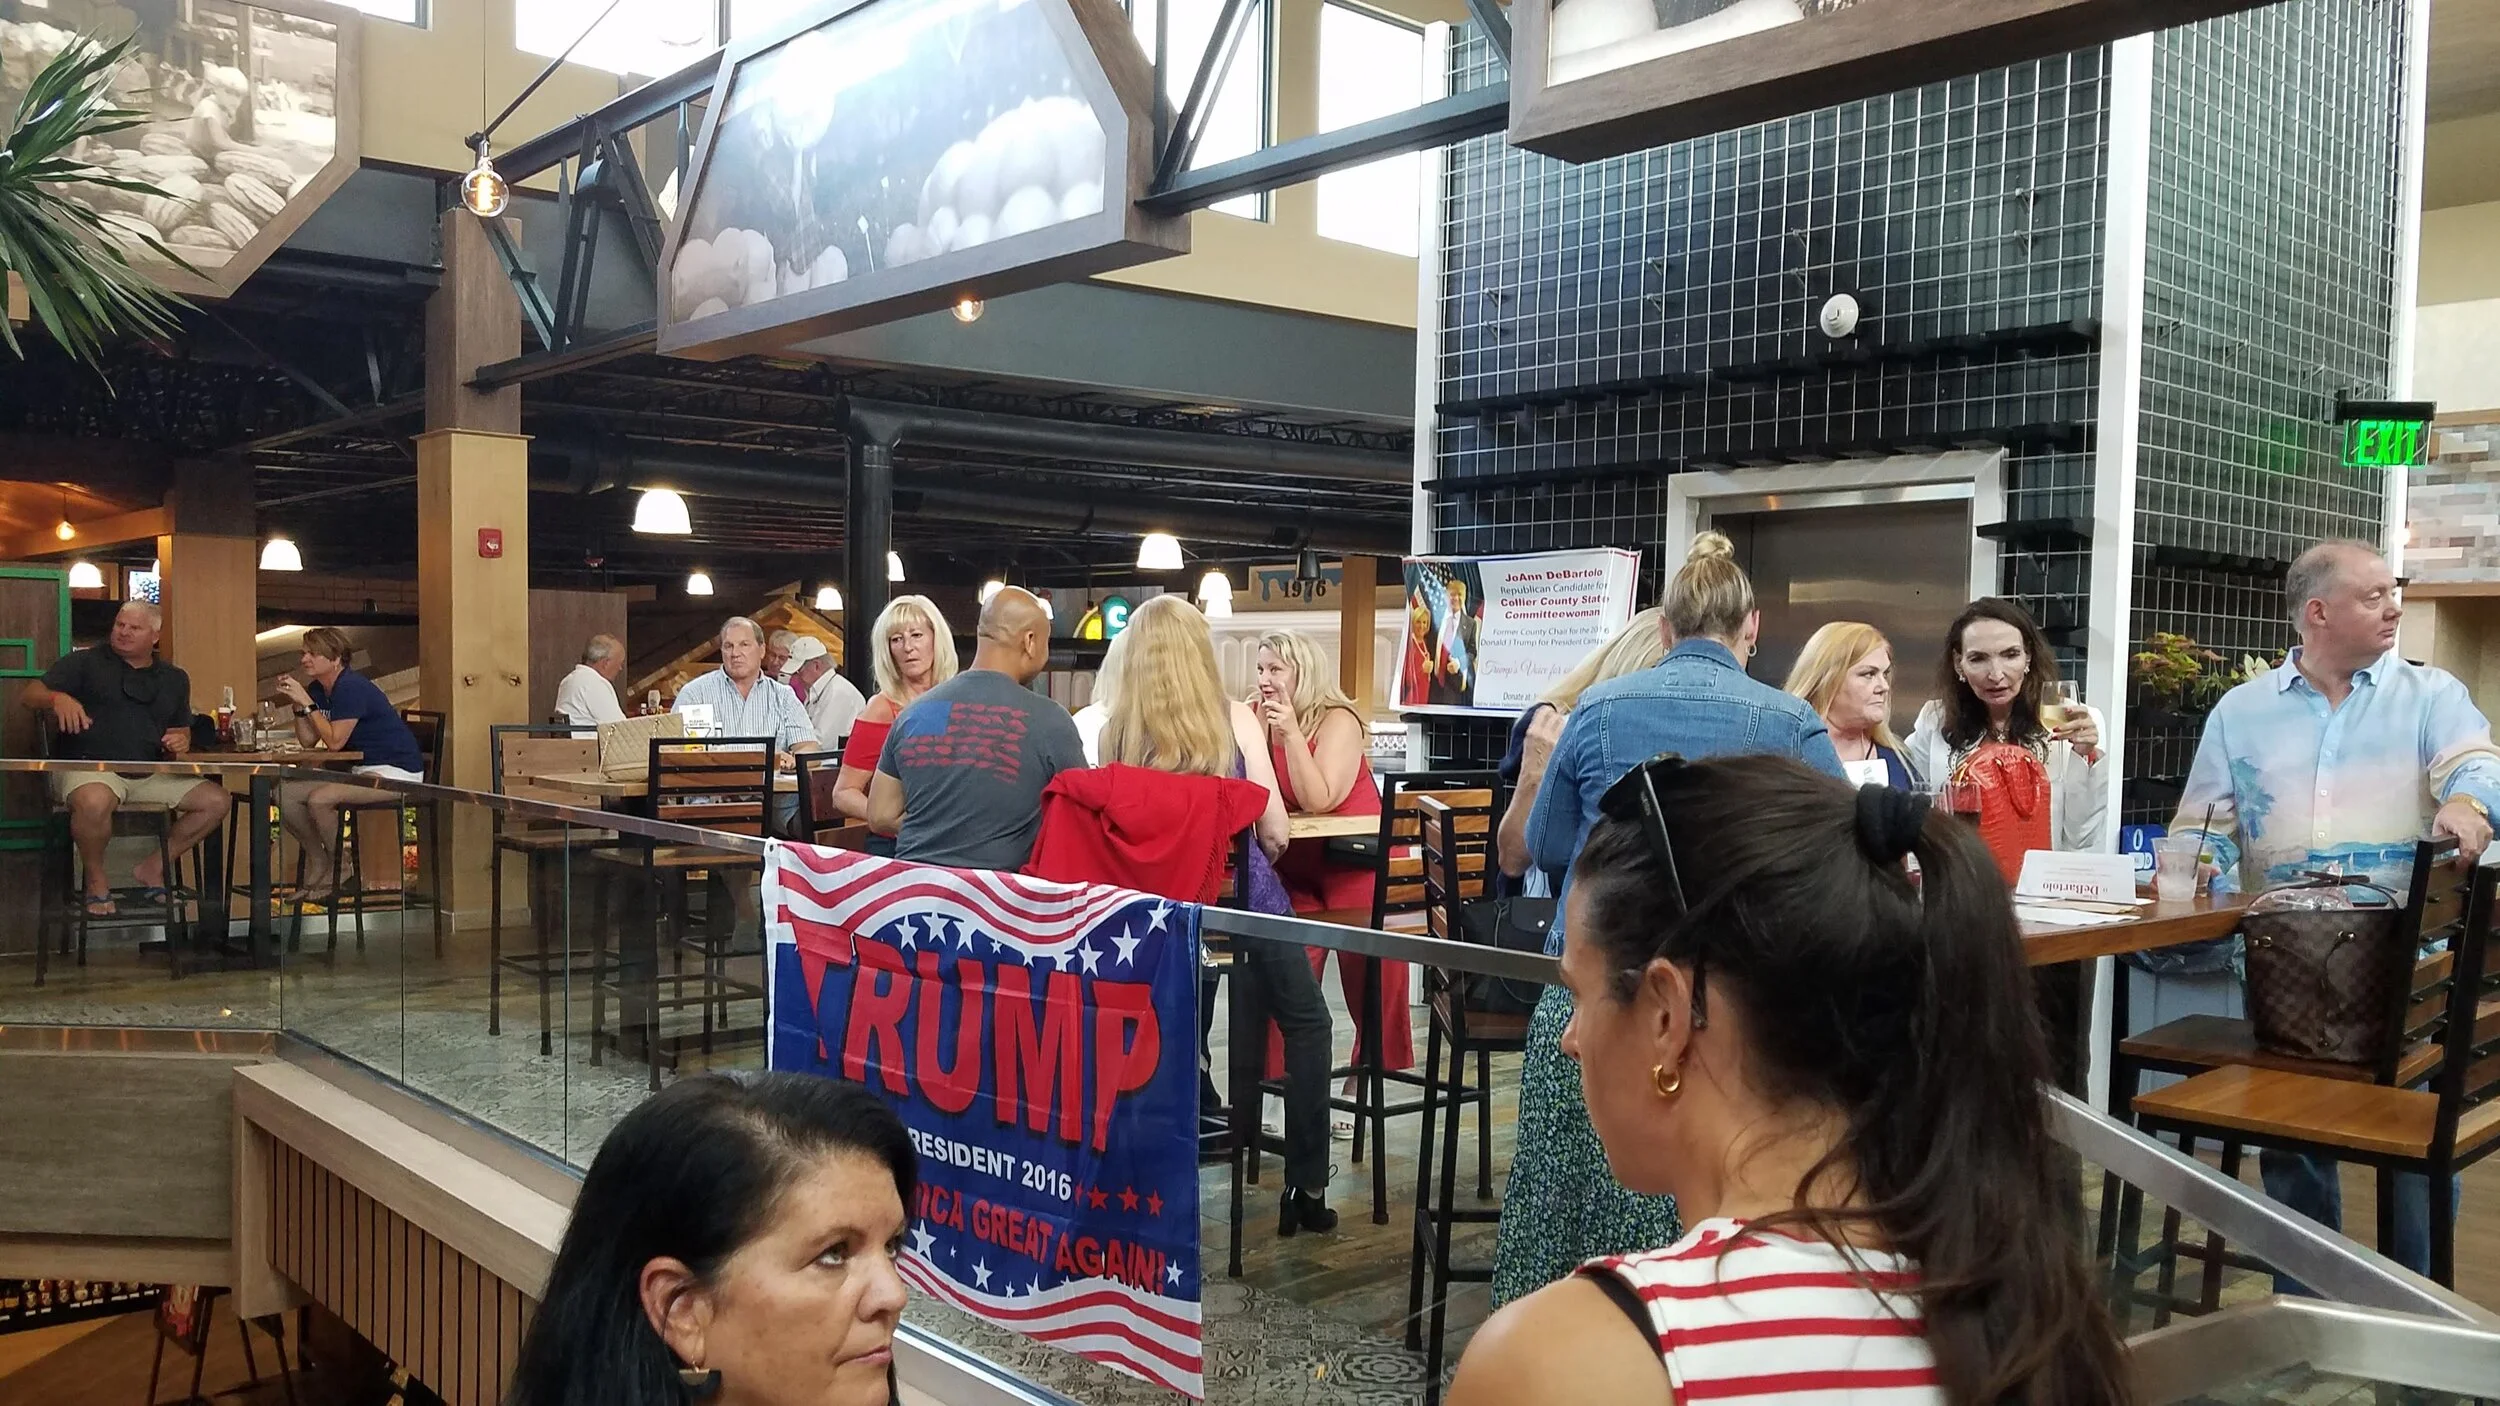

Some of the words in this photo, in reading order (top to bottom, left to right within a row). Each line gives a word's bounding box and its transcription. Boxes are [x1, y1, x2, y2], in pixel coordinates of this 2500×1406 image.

[2357, 420, 2424, 465] EXIT
[1505, 572, 1543, 582] JoAnn
[1546, 568, 1603, 580] DeBartolo
[1283, 580, 1326, 598] 1976
[1500, 584, 1551, 596] Republican
[1553, 582, 1595, 593] Candidate
[1596, 580, 1608, 589] for
[1500, 598, 1537, 607] Collier
[1540, 596, 1578, 607] County
[1581, 594, 1610, 604] State
[1505, 609, 1600, 619] Committeewoman
[1493, 628, 1519, 636] Former
[1520, 628, 1547, 637] County
[1548, 626, 1568, 636] Chair
[1569, 626, 1579, 635] for
[1580, 626, 1590, 634] the
[1480, 638, 1507, 647] Donald
[1513, 638, 1537, 648] Trump
[1538, 638, 1550, 646] for
[1550, 637, 1582, 647] President
[1583, 637, 1604, 646] Camp
[1480, 659, 1518, 679] Trump's
[1502, 691, 1525, 701] Donate
[1525, 693, 1531, 701] at
[2042, 882, 2099, 895] DeBartolo
[792, 920, 1161, 1153] TRUMP
[906, 1126, 1016, 1181] RESIDENT
[1021, 1160, 1073, 1201] 2016
[971, 1198, 1054, 1265] GREAT
[1054, 1231, 1166, 1296] AGAIN!
